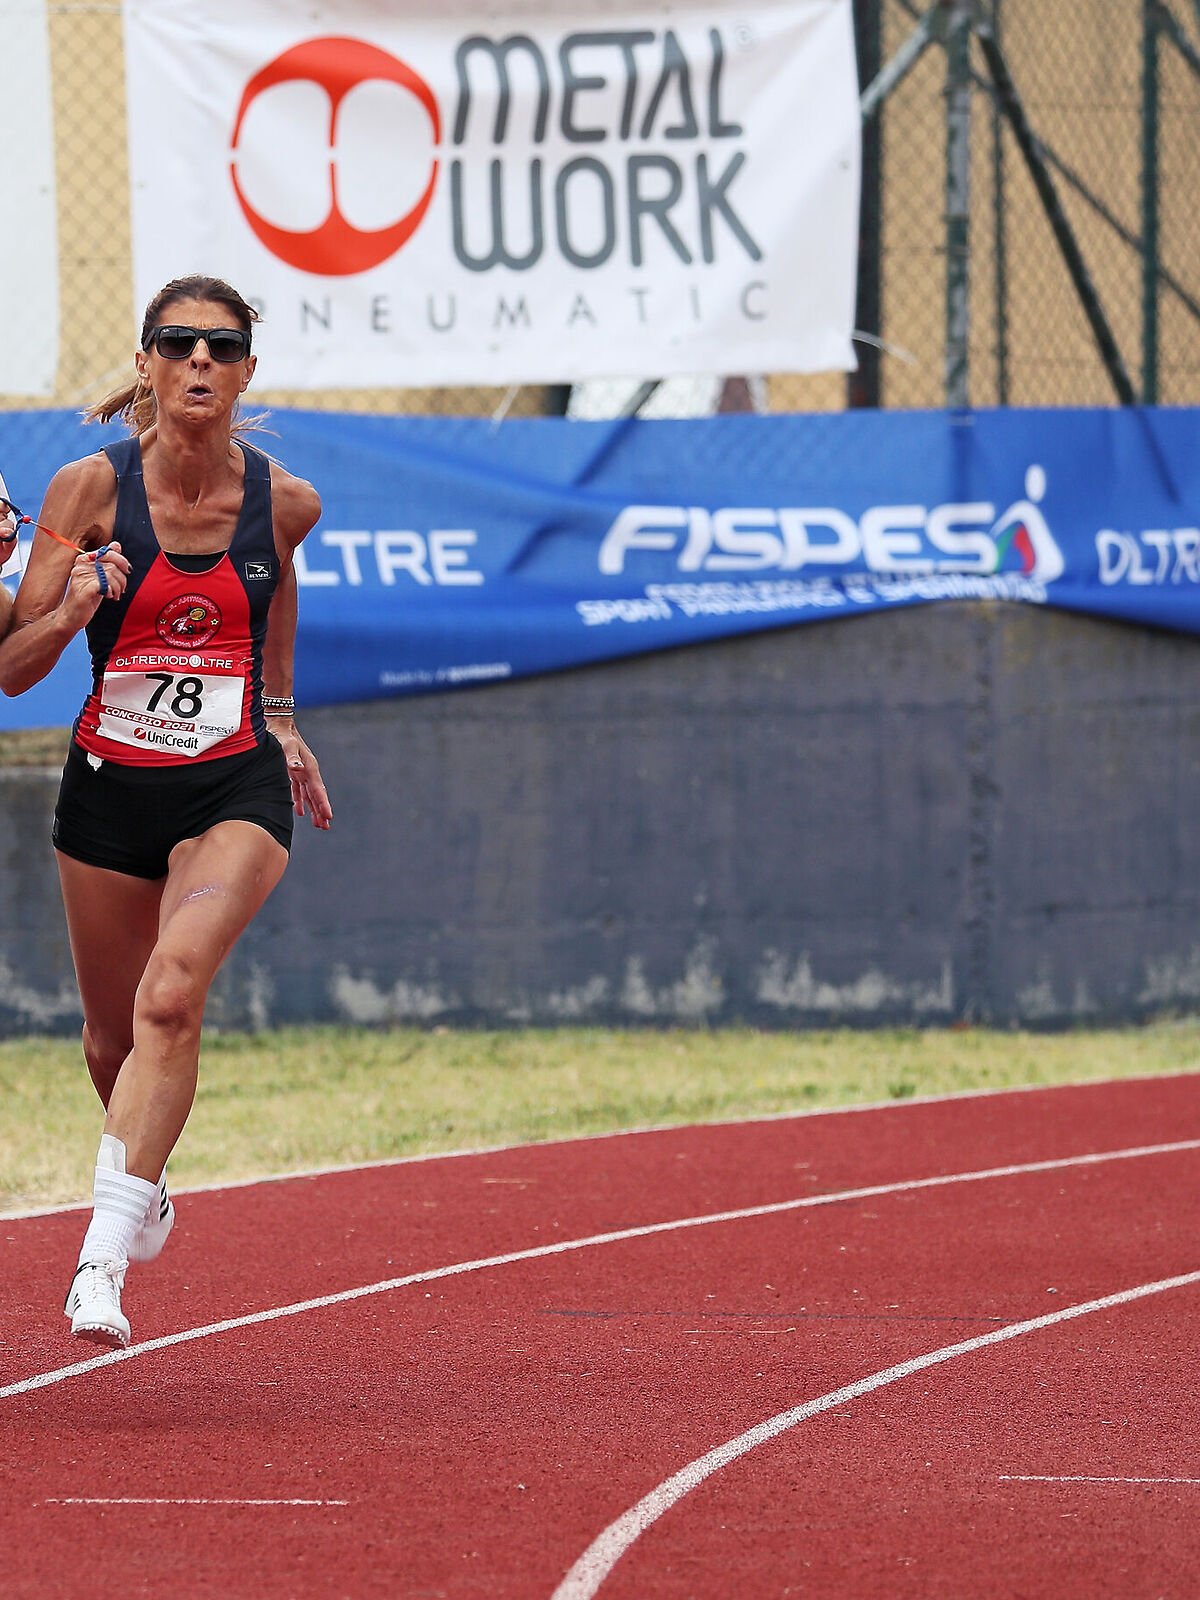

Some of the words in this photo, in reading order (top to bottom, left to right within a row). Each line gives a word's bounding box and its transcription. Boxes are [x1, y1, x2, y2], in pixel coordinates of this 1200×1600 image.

[453, 28, 742, 145] METAL
[450, 151, 763, 272] WORK
[598, 502, 998, 576] FISPES
[115, 654, 234, 669] OLTREMODOLTRE
[145, 673, 204, 719] 78
[104, 707, 162, 728] CONCESIO
[162, 719, 194, 732] 2021
[147, 730, 199, 750] UniCredit
